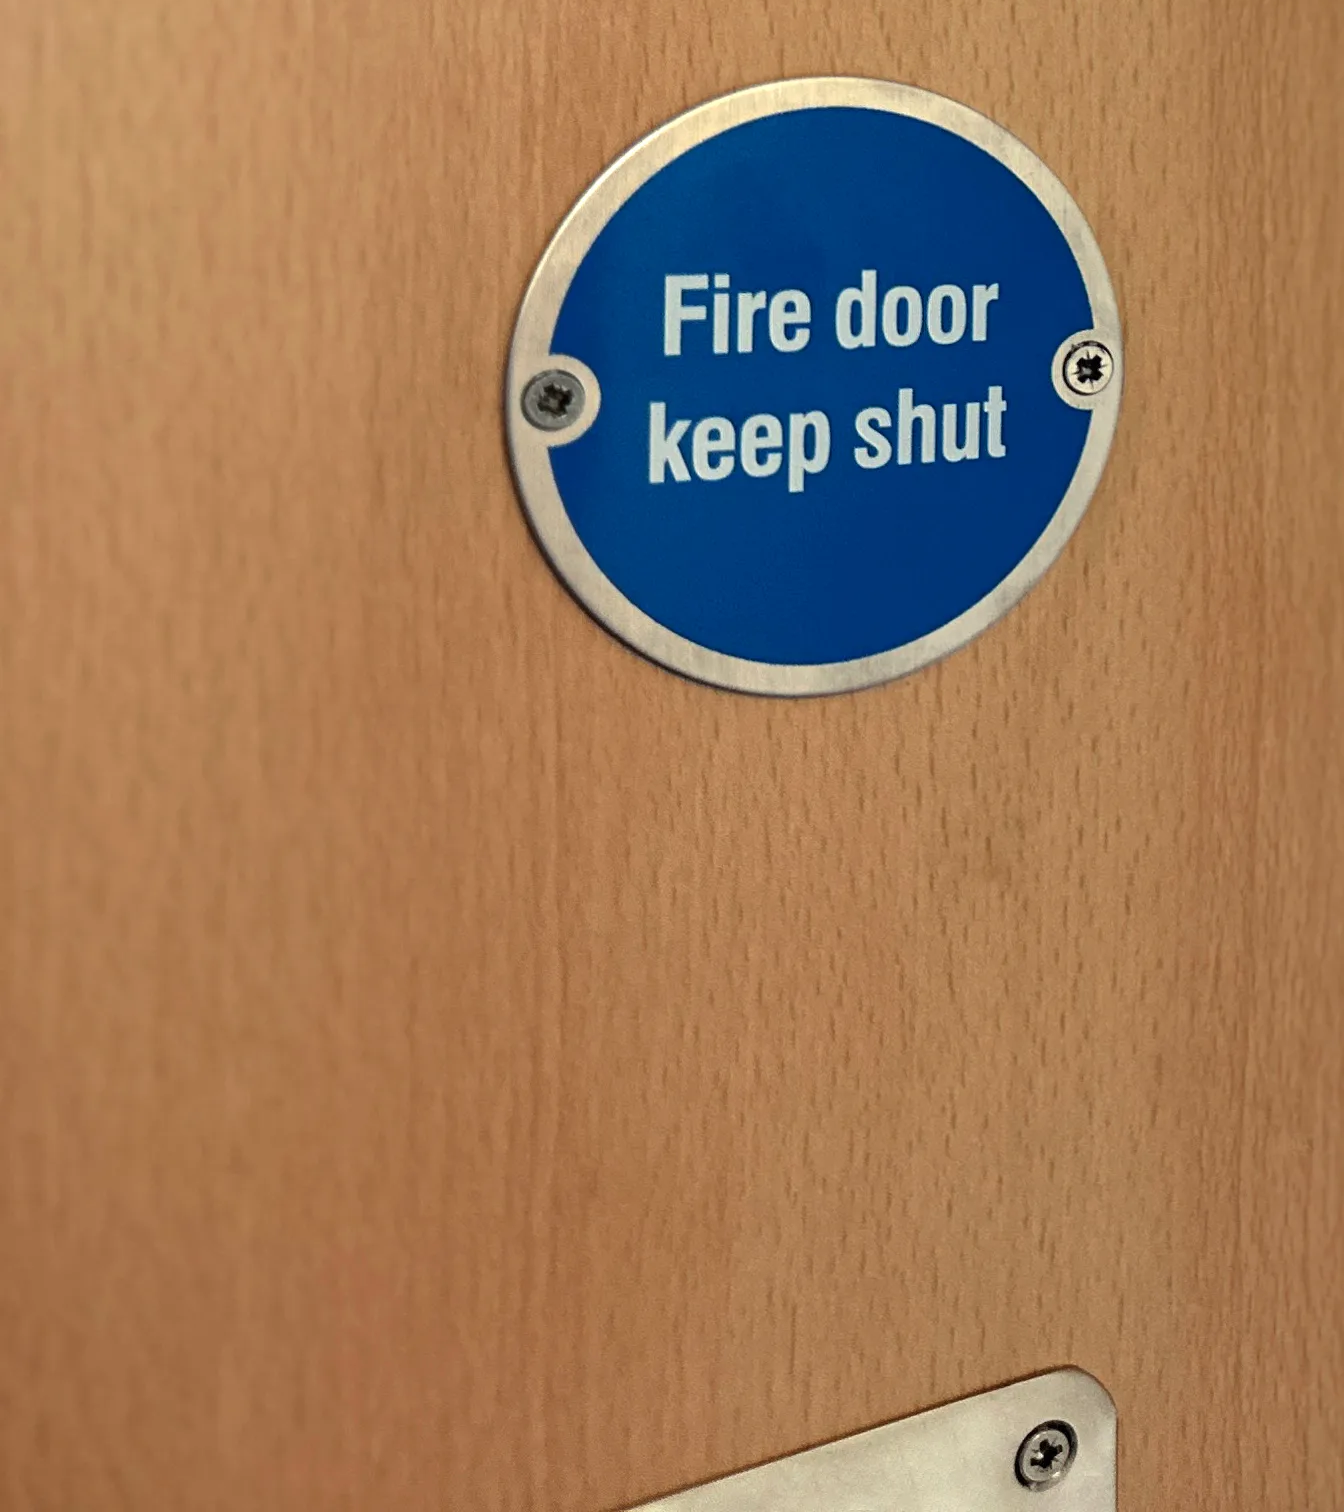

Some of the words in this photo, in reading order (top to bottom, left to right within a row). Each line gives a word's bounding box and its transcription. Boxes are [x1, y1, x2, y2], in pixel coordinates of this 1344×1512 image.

[664, 274, 811, 356] Fire
[836, 270, 999, 349] door
[649, 402, 830, 492] keep
[854, 386, 1007, 469] shut
